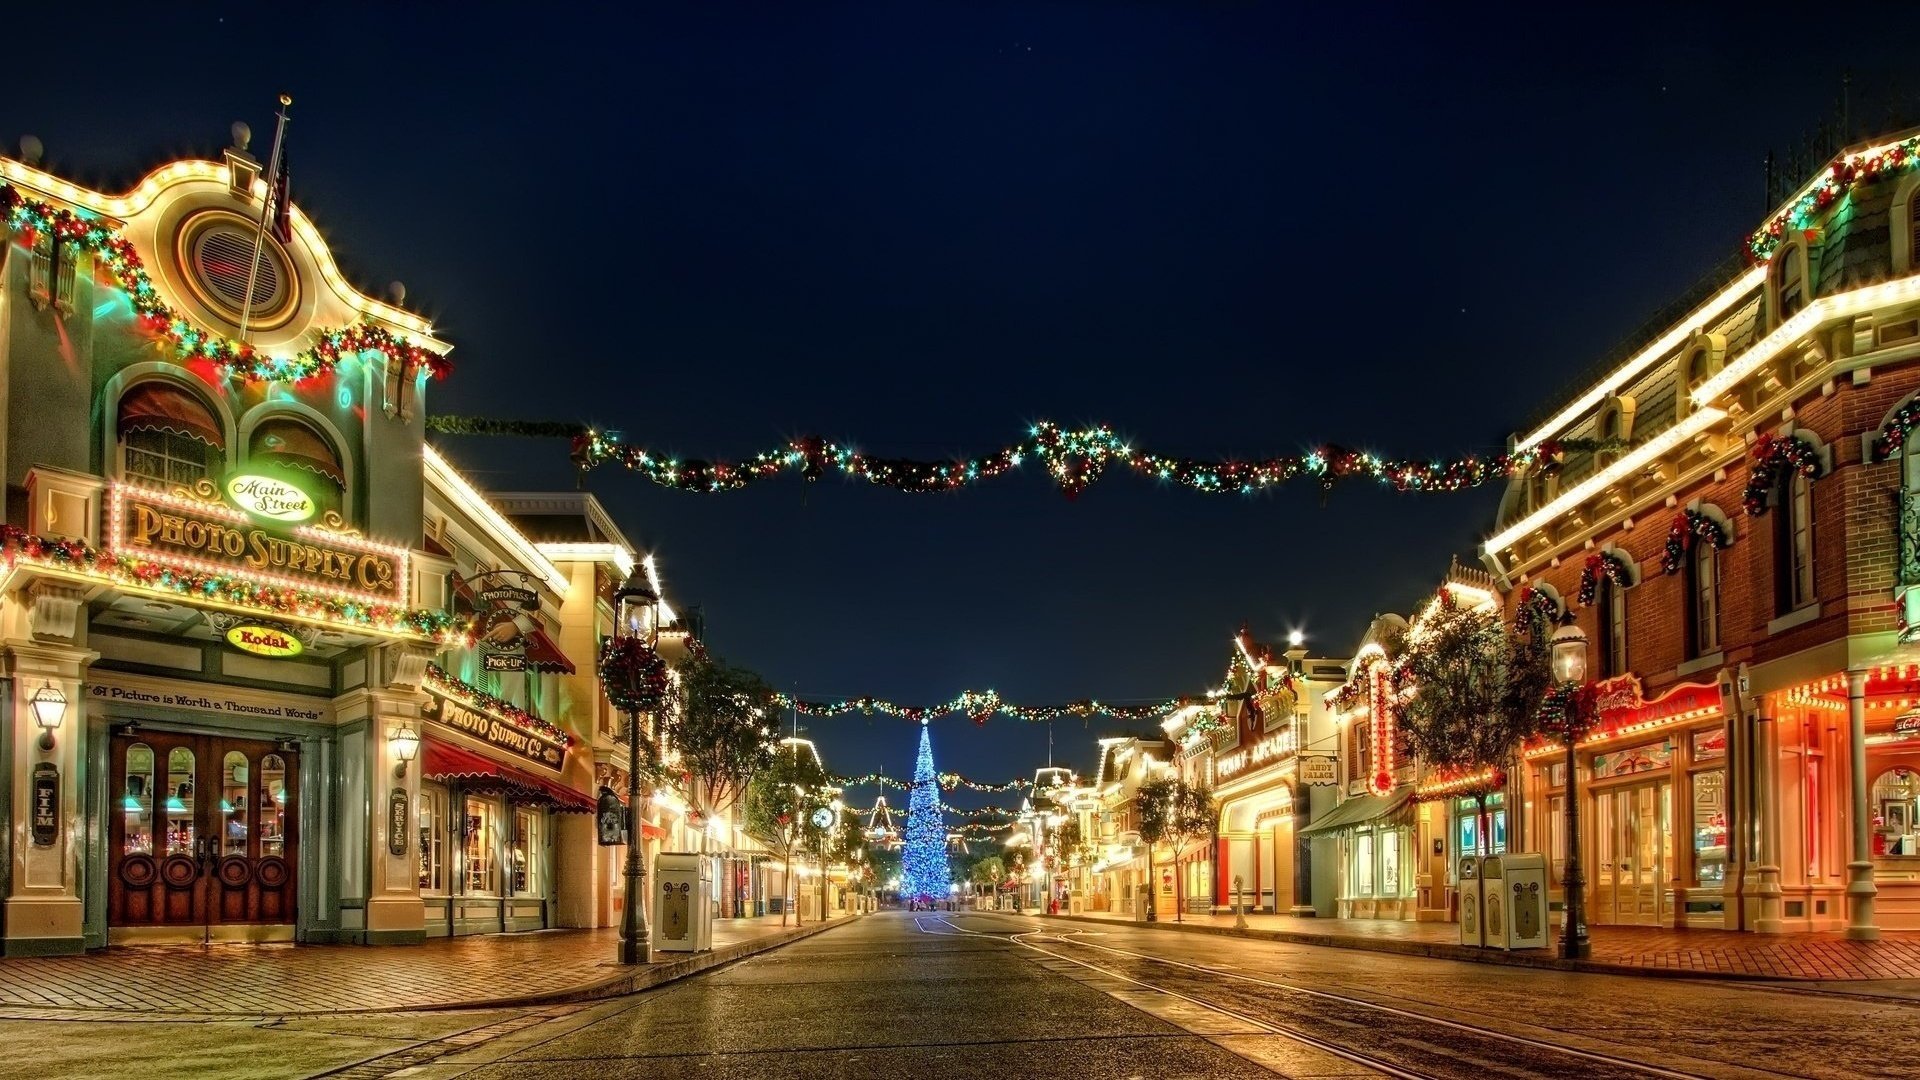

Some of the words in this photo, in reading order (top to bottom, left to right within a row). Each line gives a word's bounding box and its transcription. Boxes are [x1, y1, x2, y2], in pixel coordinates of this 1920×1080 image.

[233, 480, 298, 497] Main
[254, 495, 309, 515] Street
[134, 503, 246, 557] PHOTO
[245, 530, 356, 580] SUPPLY
[240, 631, 290, 650] Kodak
[488, 657, 523, 667] PICK-UP
[111, 687, 160, 703] Picture
[163, 694, 174, 704] is
[174, 695, 211, 709] Worth
[214, 702, 223, 710] a
[223, 701, 282, 716] Thousand
[284, 706, 324, 720] Words"
[441, 699, 488, 736] PHOTO
[489, 721, 529, 752] SUPPLY
[37, 788, 54, 826] FILM
[394, 802, 405, 846] SERVICE
